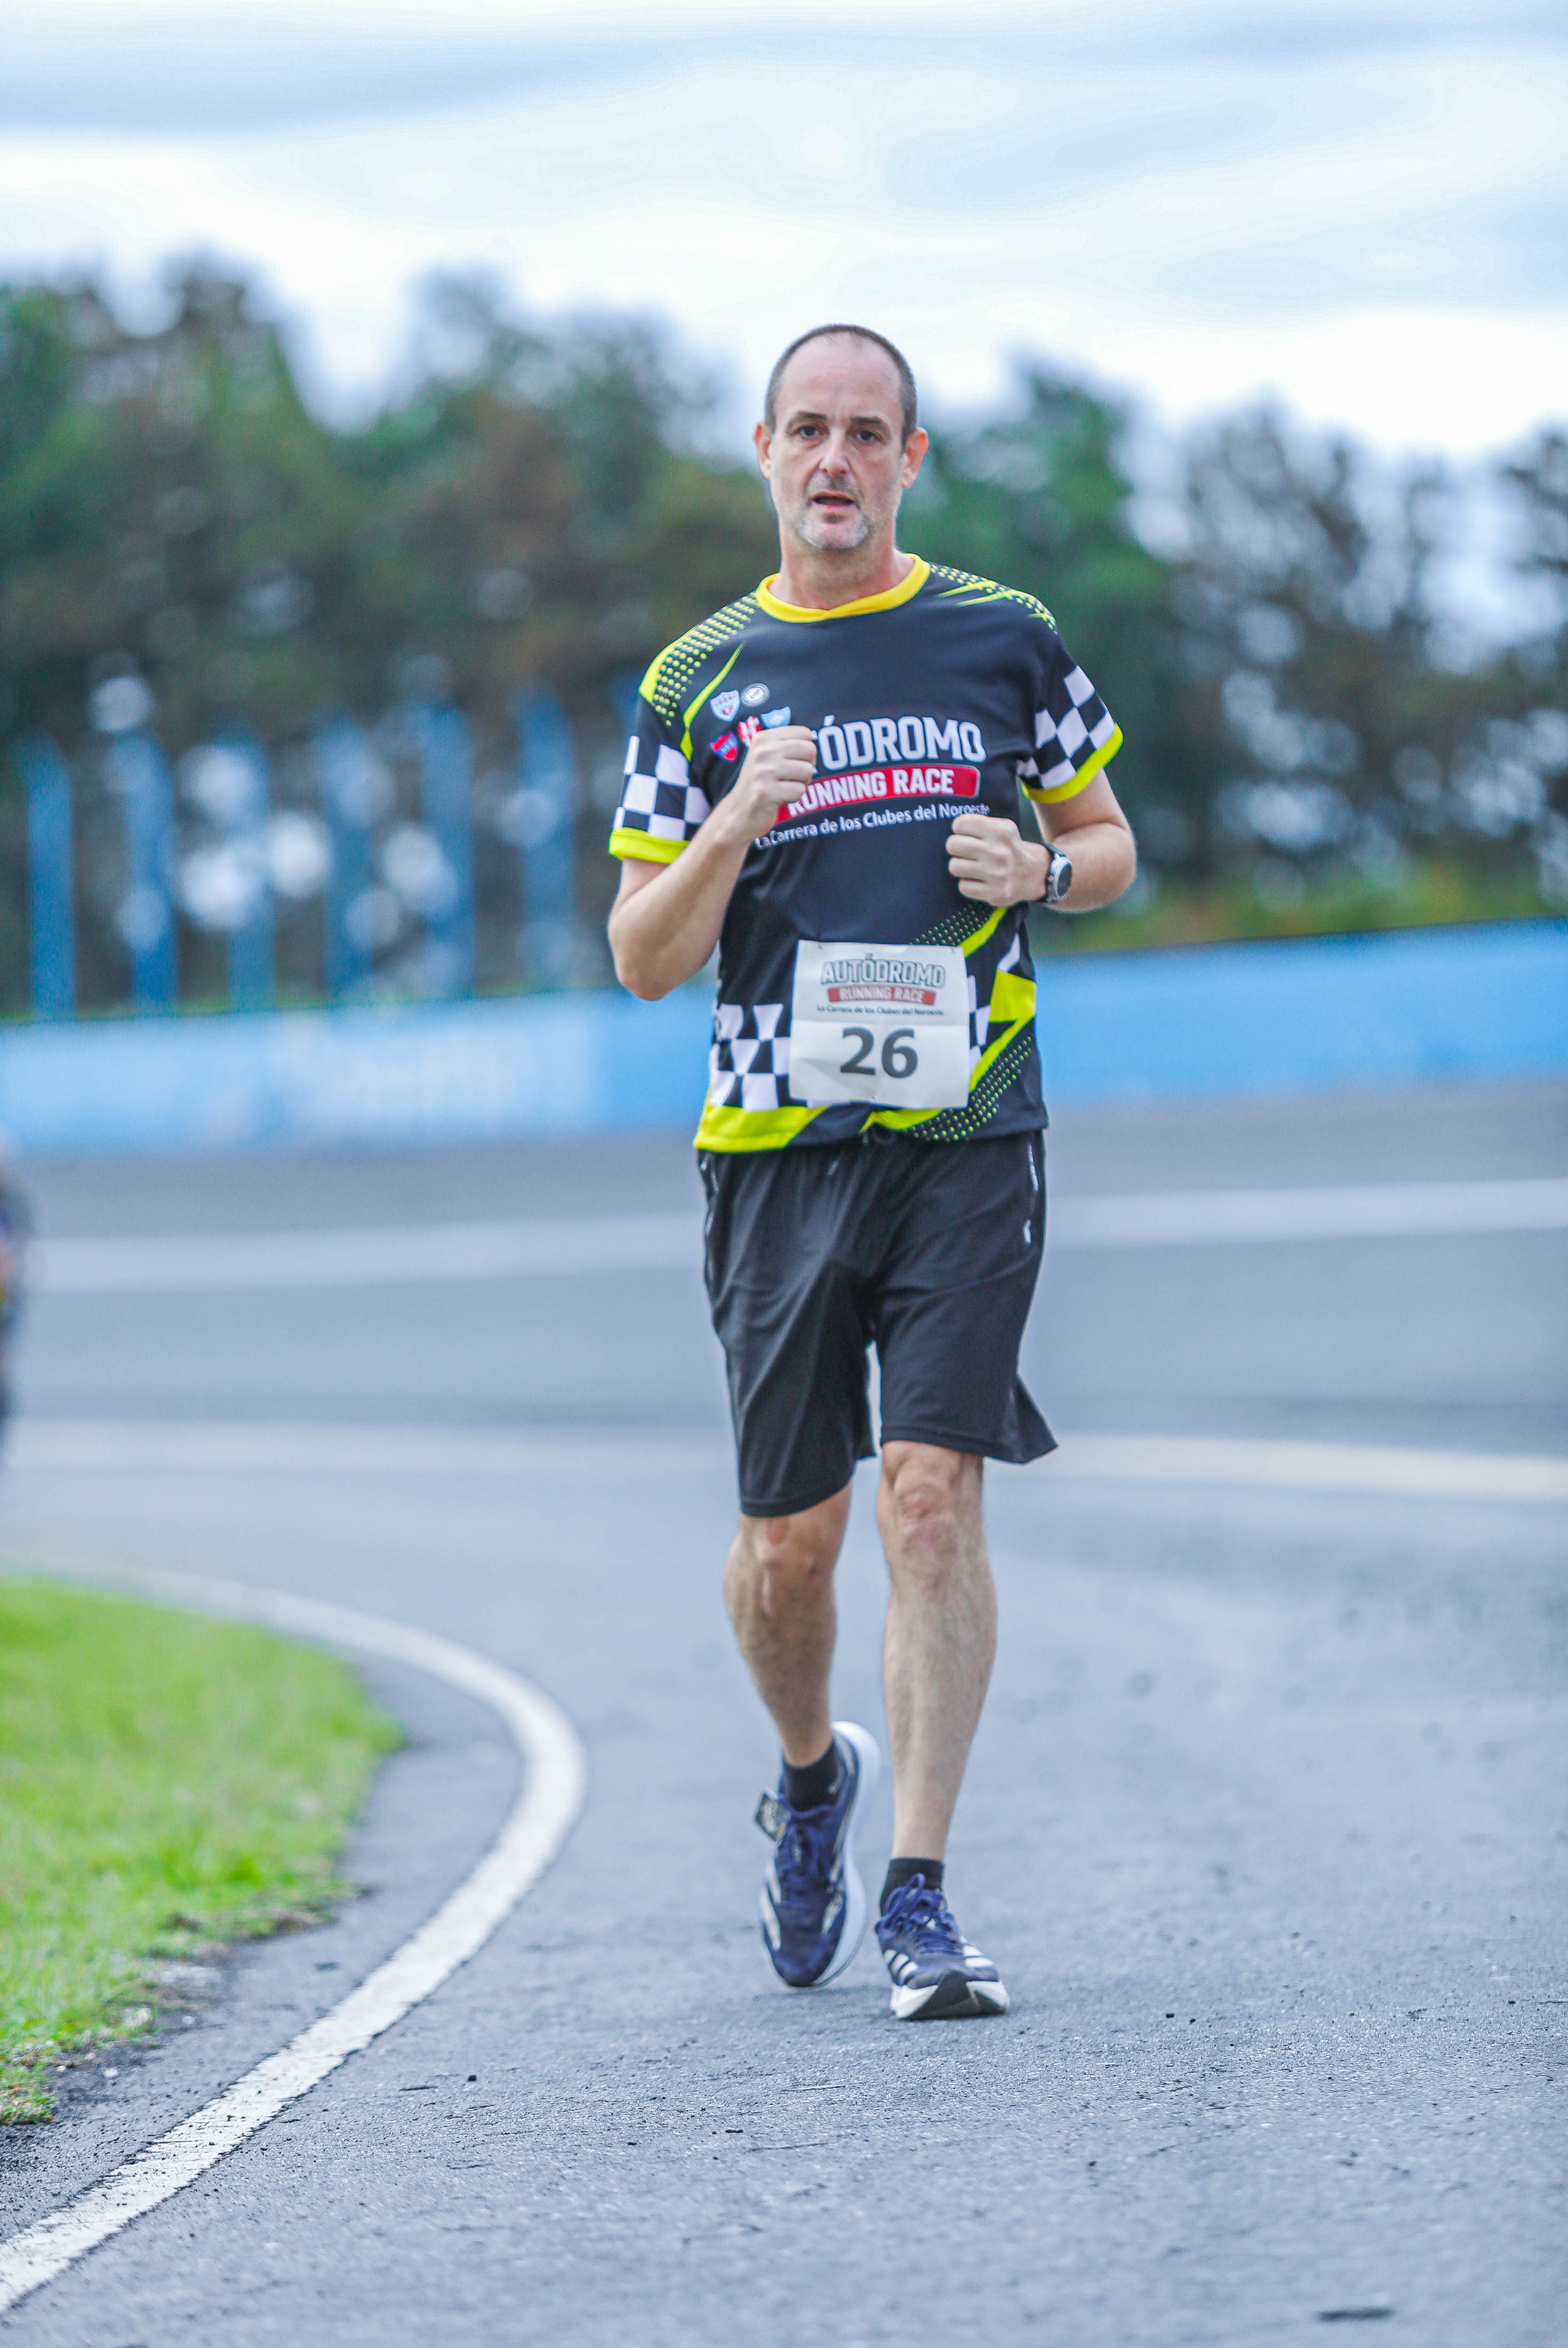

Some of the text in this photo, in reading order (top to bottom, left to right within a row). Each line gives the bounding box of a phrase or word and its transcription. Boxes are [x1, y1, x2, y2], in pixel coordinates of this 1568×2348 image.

[811, 714, 987, 774] ÓDROMO
[892, 768, 954, 794] RACE
[754, 836, 771, 849] La
[770, 824, 818, 846] Carrera
[819, 818, 839, 835] de
[839, 816, 862, 832] los
[863, 809, 912, 827] Clubes
[913, 804, 937, 821] del
[820, 953, 946, 988] AUTÓDROMO
[839, 986, 924, 1003] RUNNING RACE
[840, 1026, 919, 1079] 26
